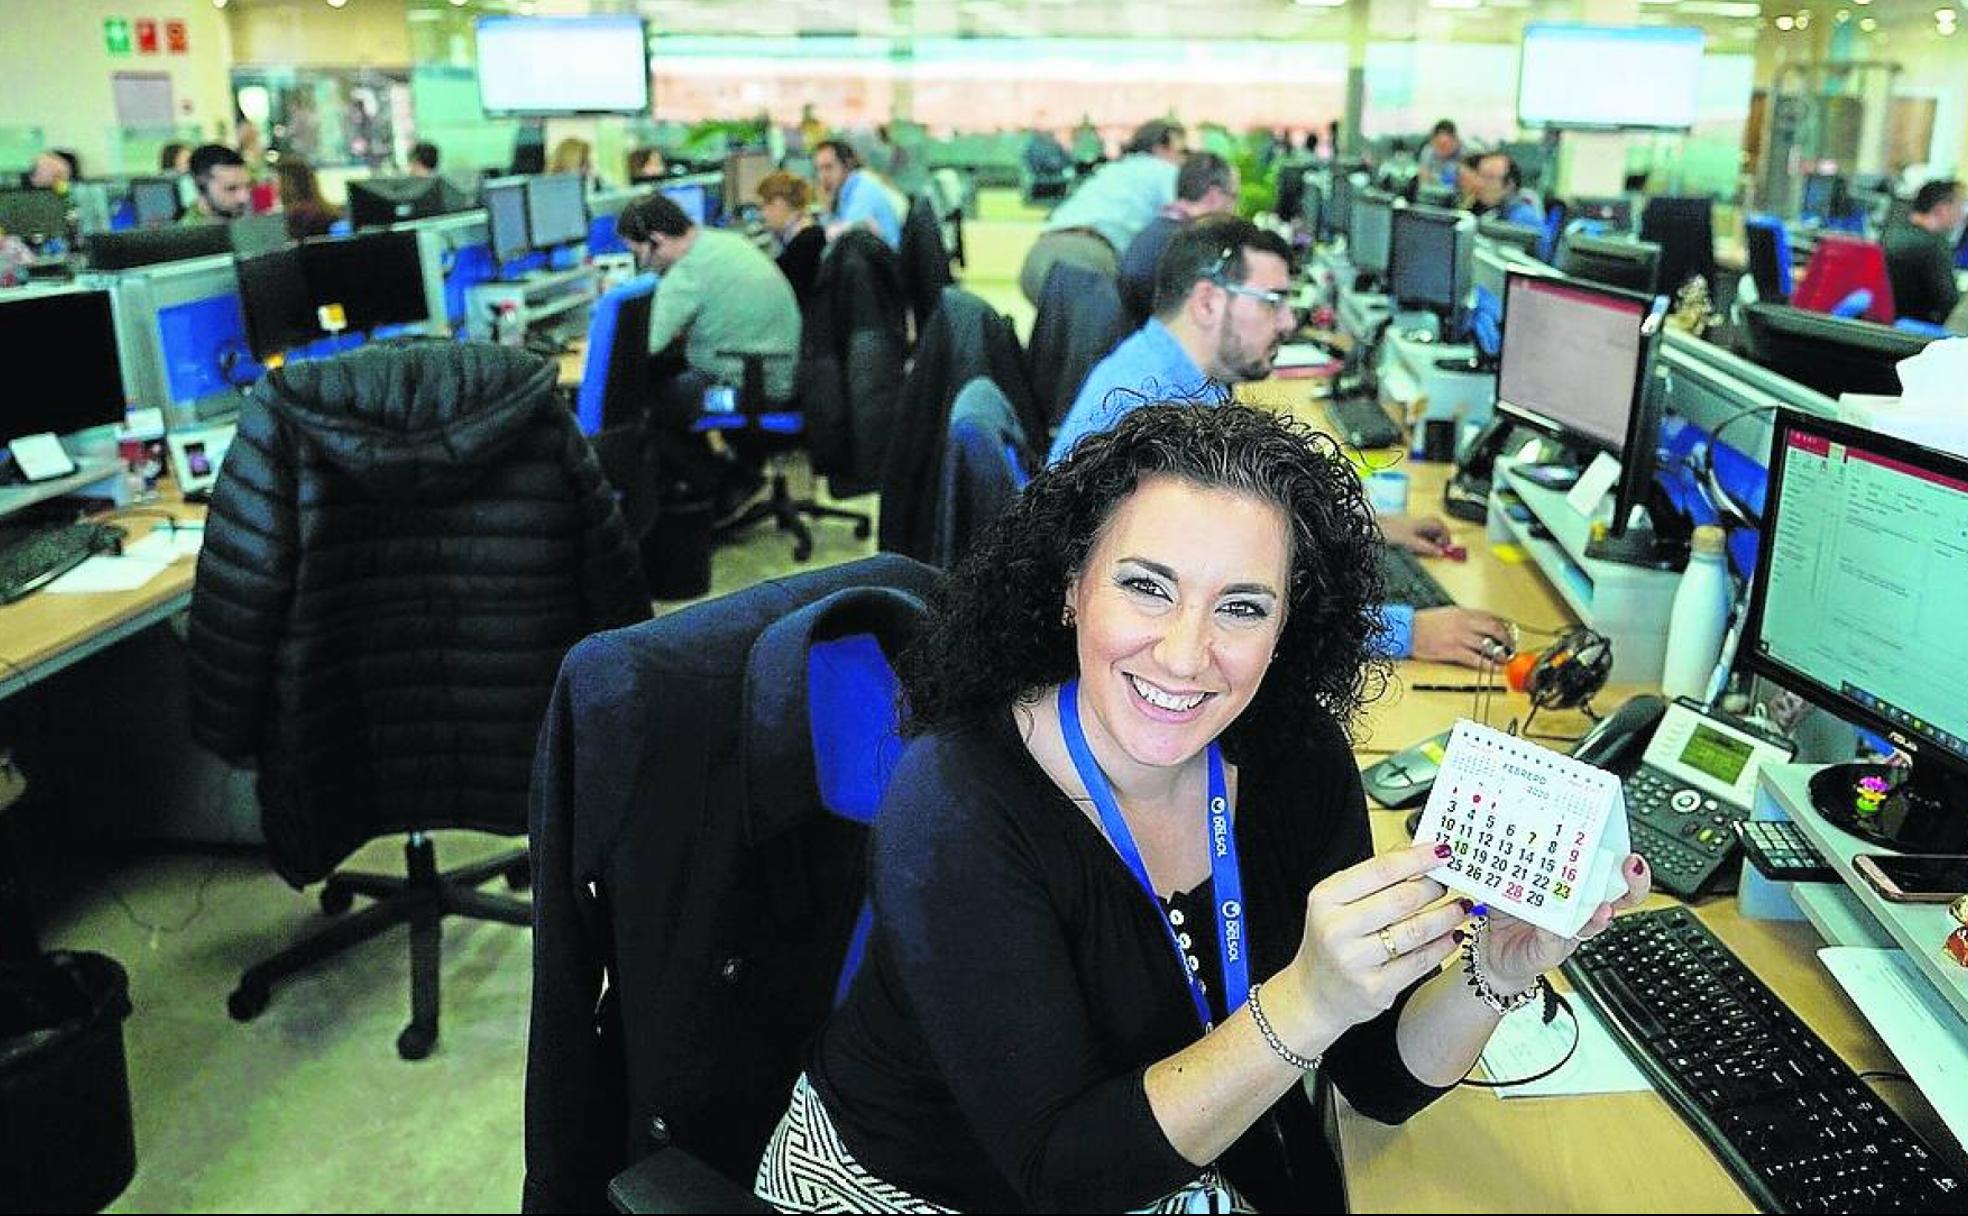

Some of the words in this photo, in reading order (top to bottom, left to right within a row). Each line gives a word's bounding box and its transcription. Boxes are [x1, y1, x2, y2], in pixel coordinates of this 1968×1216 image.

[1441, 815, 1455, 831] 10
[1460, 824, 1472, 838] 11
[1479, 831, 1494, 848] 12
[1499, 839, 1513, 855] 13
[1519, 848, 1534, 864] 14
[1541, 857, 1556, 873] 15
[1561, 865, 1577, 882] 16
[1447, 800, 1457, 812] 3
[1486, 815, 1496, 829] 5
[1506, 823, 1516, 837] 6
[1528, 831, 1537, 845] 7
[1548, 841, 1557, 854] 8
[1569, 849, 1579, 862] 9
[1556, 823, 1563, 837] 1
[1574, 831, 1585, 846] 2
[1447, 855, 1463, 872] 25
[1465, 864, 1482, 881] 26
[1484, 872, 1502, 888] 27
[1506, 882, 1524, 898] 28
[1526, 890, 1544, 907] 29
[1455, 840, 1468, 855] 18
[1473, 848, 1487, 864] 19
[1491, 855, 1508, 872] 20
[1512, 864, 1527, 880] 21
[1532, 873, 1550, 890] 22
[1553, 882, 1571, 899] 23
